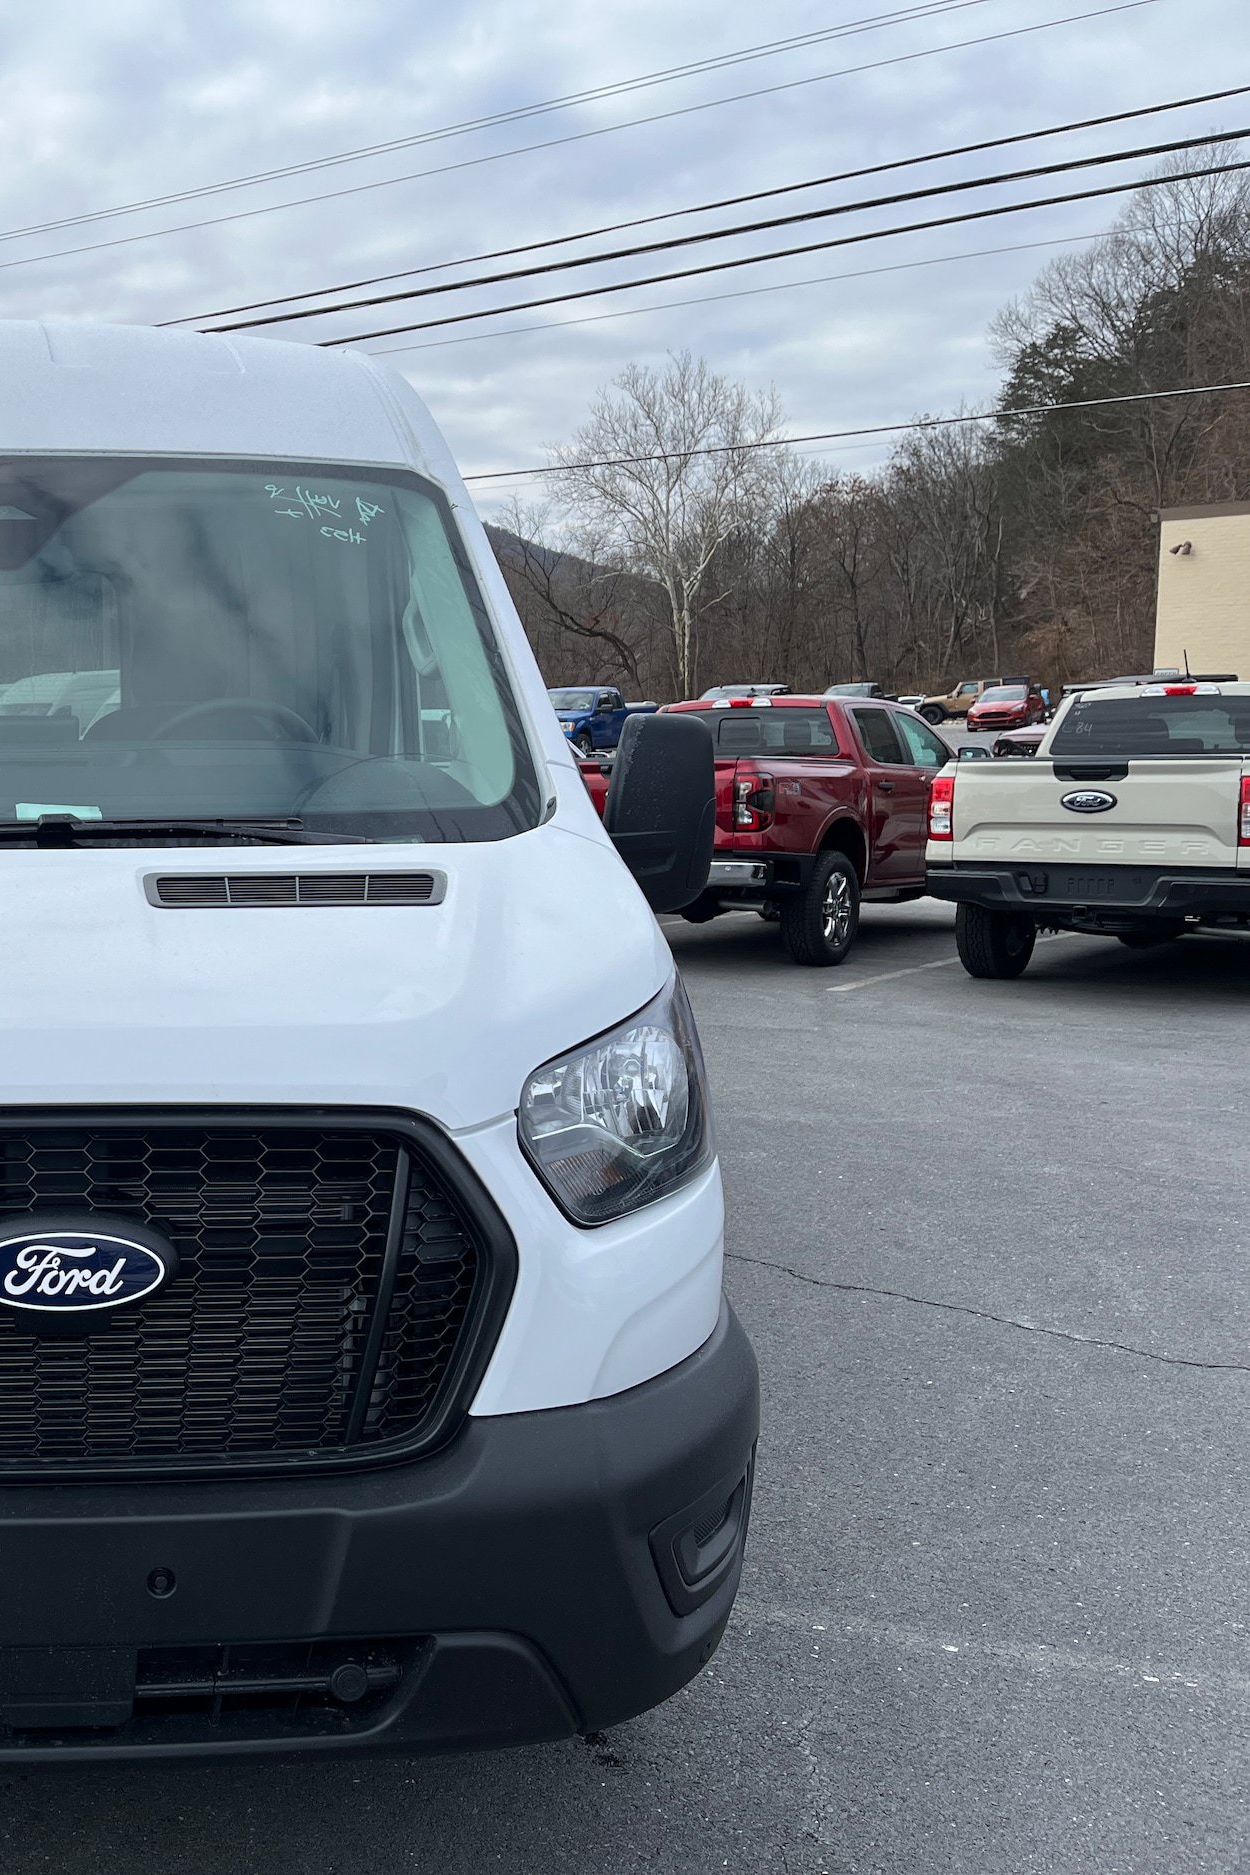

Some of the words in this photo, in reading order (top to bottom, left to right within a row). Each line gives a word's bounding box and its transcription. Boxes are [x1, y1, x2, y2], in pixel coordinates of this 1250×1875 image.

[1073, 795, 1102, 807] Ford
[973, 837, 1210, 855] RANGER
[3, 1244, 127, 1296] Ford
